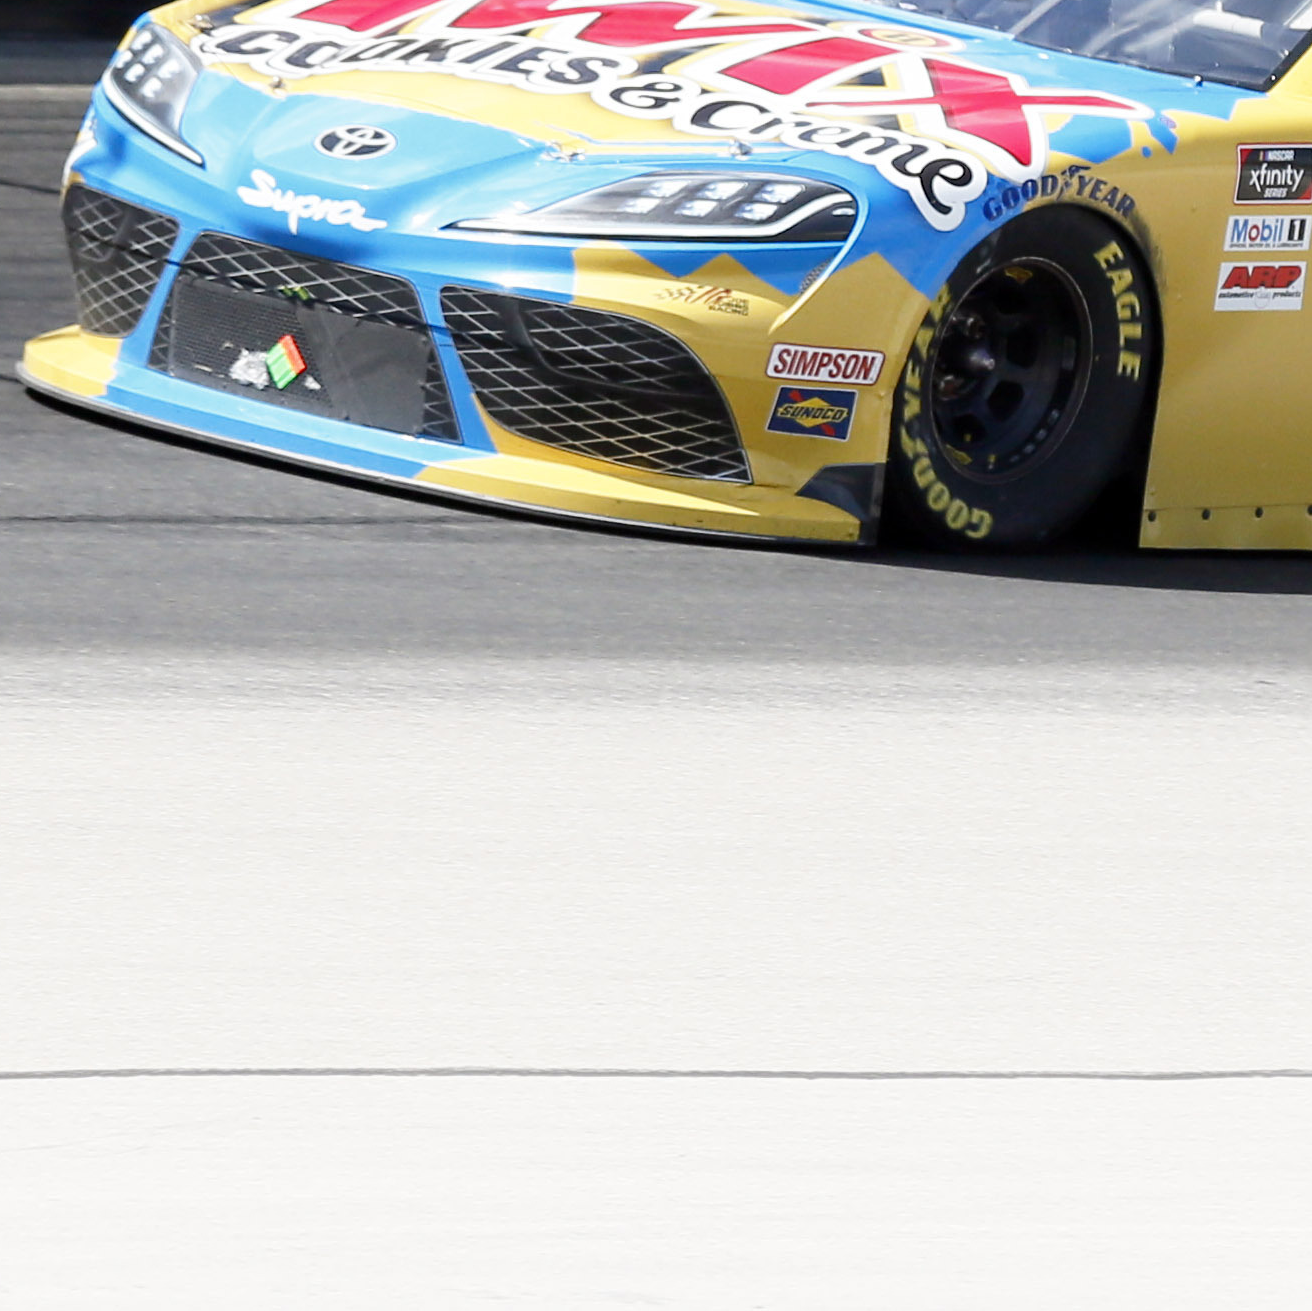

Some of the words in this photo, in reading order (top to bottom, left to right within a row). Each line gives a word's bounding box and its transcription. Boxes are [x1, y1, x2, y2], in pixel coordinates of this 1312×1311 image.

[221, 28, 618, 85] COOKIES
[612, 73, 681, 110] &
[691, 98, 973, 216] Creme
[1249, 162, 1305, 193] xfinity
[1264, 187, 1288, 198] SERIES
[238, 169, 387, 235] Supra
[1231, 218, 1284, 242] Mobil
[1289, 218, 1306, 241] 1
[1222, 265, 1302, 289] ARP
[1093, 240, 1142, 381] EAGLE
[773, 348, 877, 381] SIMPSON
[780, 405, 846, 421] SUNOCO
